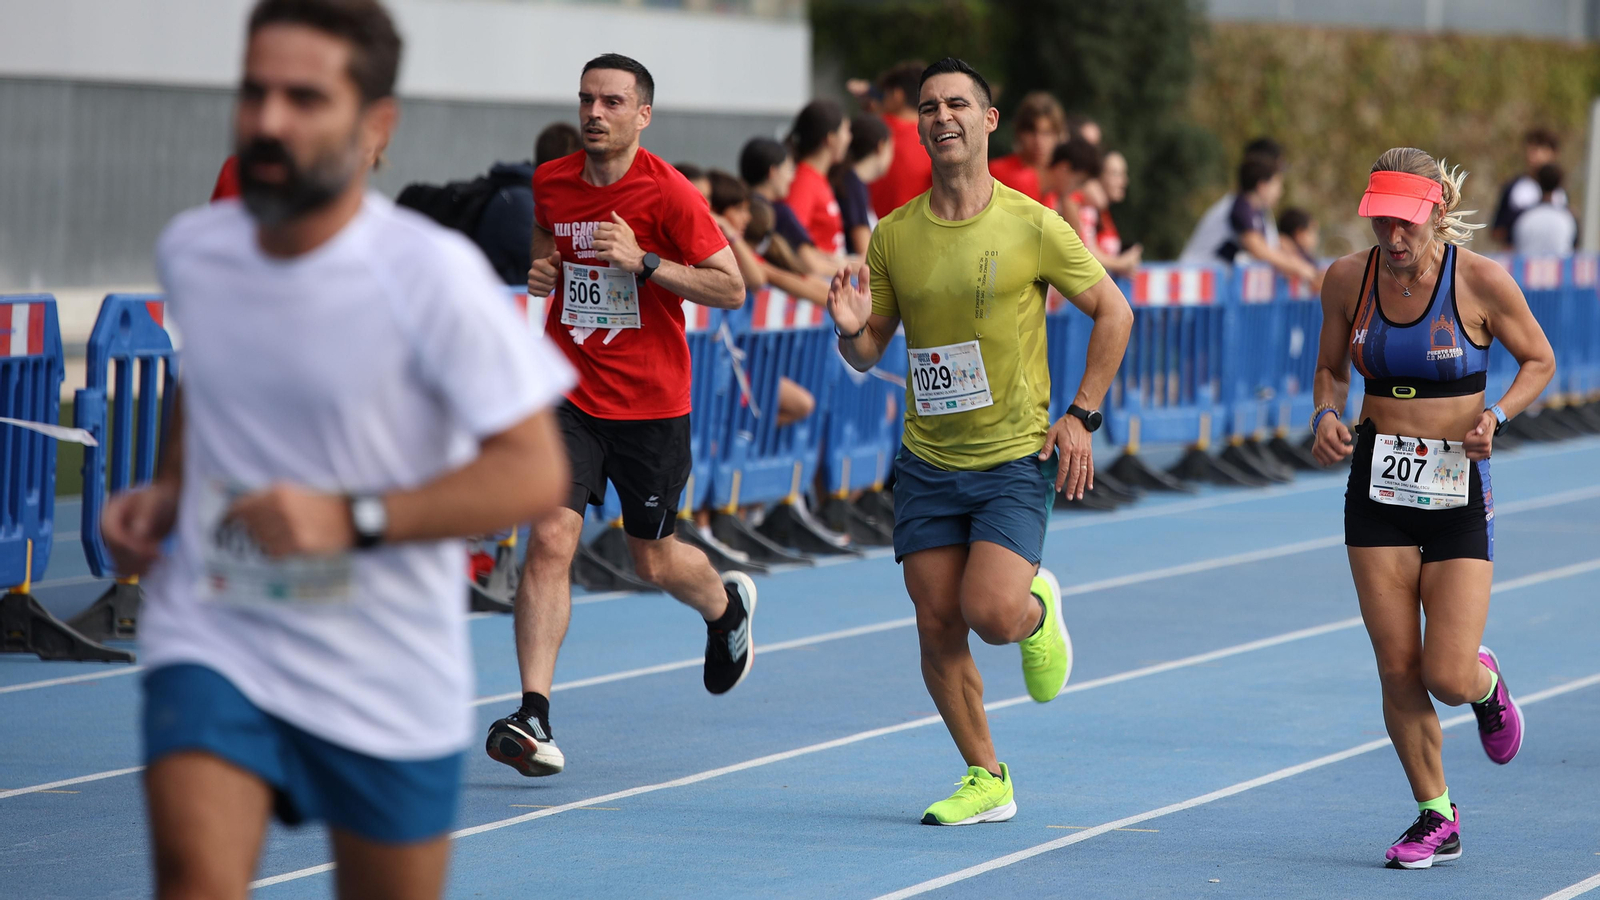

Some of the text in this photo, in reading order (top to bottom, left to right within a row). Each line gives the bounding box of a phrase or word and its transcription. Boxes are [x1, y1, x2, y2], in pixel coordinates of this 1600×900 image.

[572, 222, 600, 236] CARR
[569, 280, 601, 305] 506
[914, 366, 952, 391] 1029
[1381, 455, 1427, 483] 207
